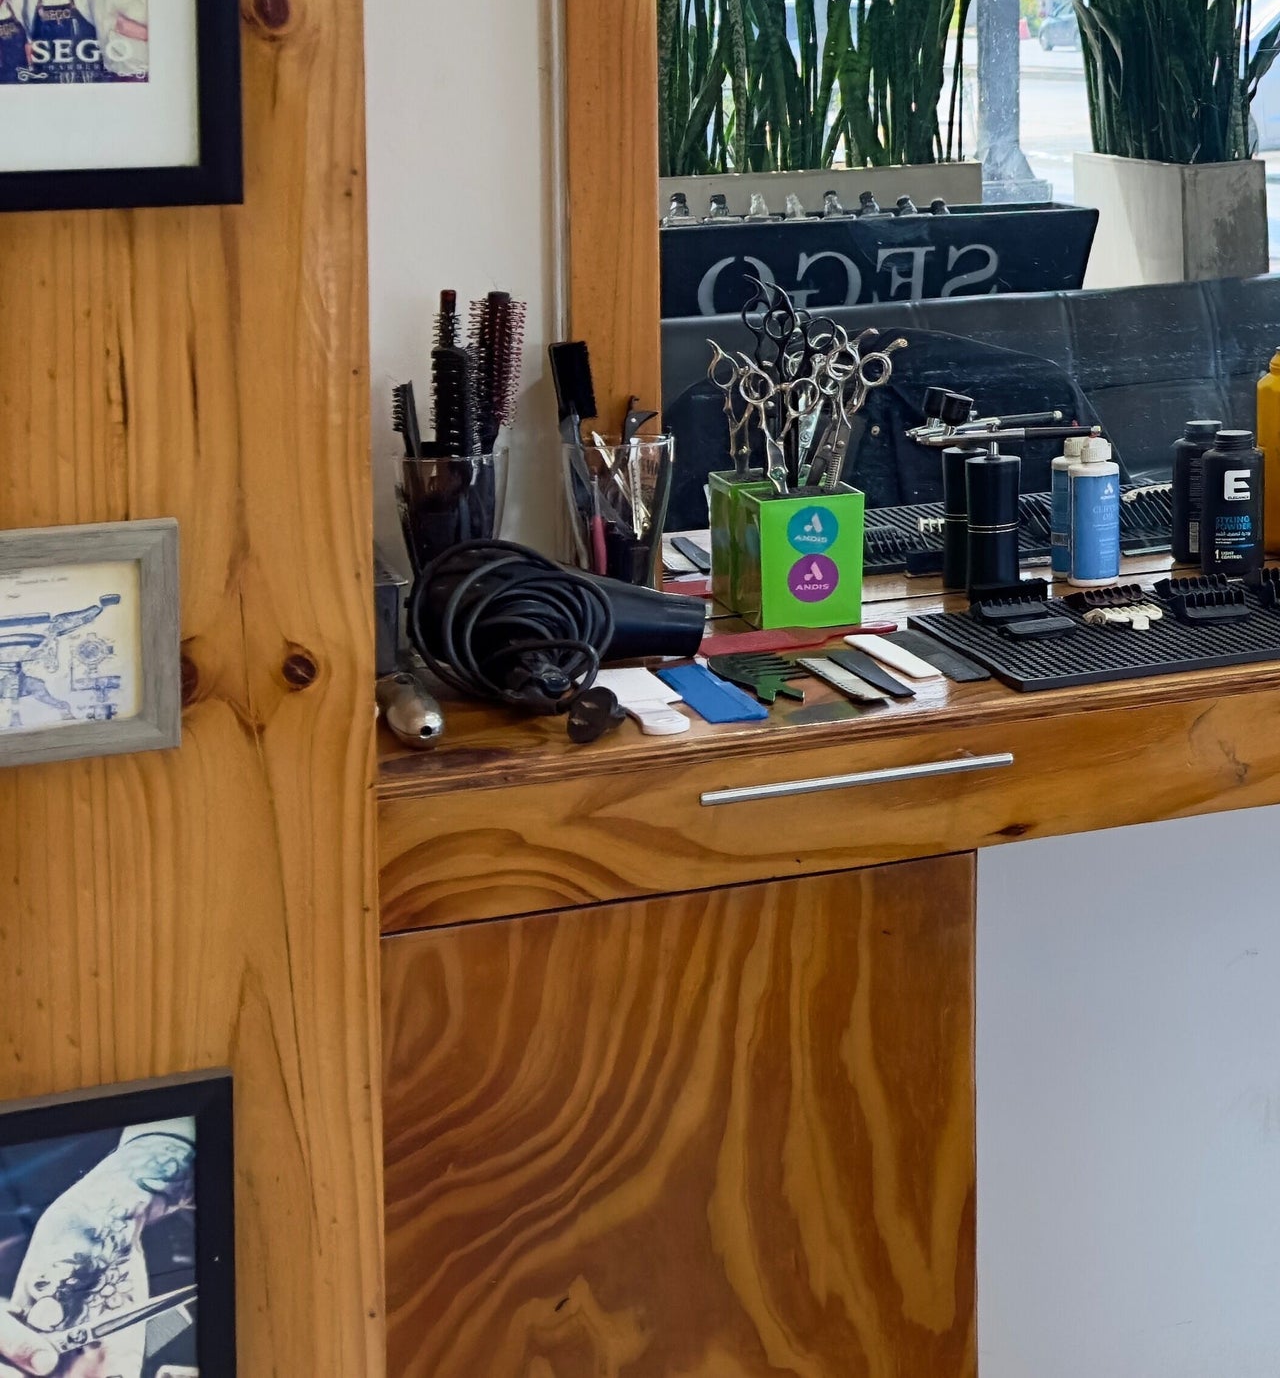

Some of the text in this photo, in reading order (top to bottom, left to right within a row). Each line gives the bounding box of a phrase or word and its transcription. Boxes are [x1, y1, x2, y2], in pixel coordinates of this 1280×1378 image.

[31, 39, 135, 64] SEGO
[1215, 515, 1250, 523] STYLING
[1215, 522, 1251, 530] POWDER
[794, 535, 828, 543] ANDIS
[1214, 549, 1220, 560] 1
[795, 583, 830, 591] ANDIS
